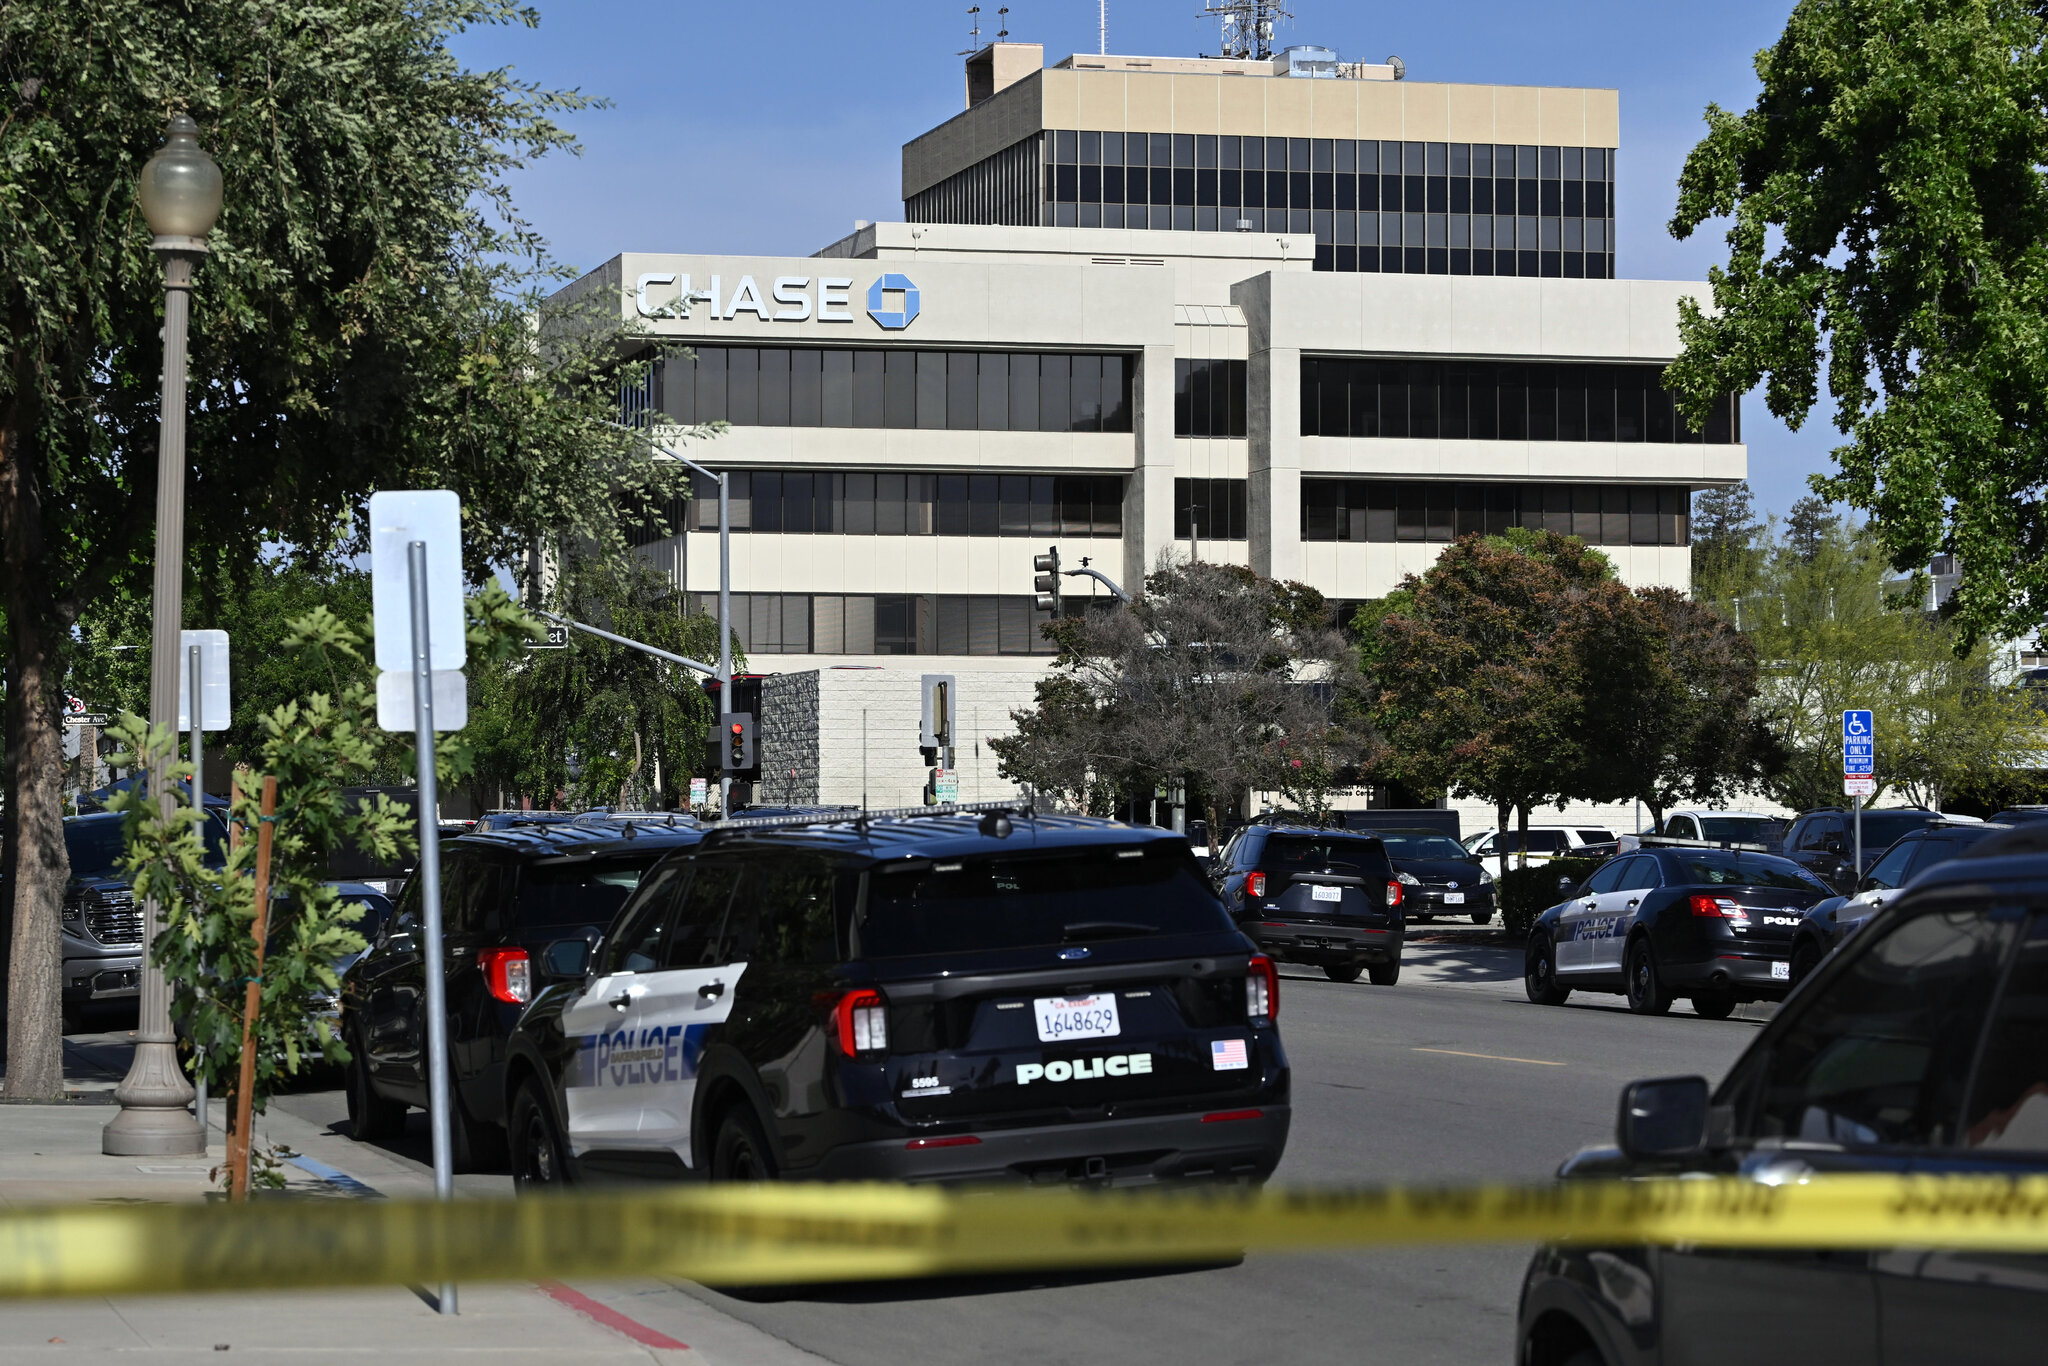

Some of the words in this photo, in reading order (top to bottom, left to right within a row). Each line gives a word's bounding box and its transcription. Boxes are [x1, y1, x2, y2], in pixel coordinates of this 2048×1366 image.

[636, 272, 854, 322] CHASE
[1845, 735, 1872, 745] PARKING
[1849, 745, 1867, 755] ONLY
[1848, 757, 1869, 765] MINIMUM
[1575, 917, 1616, 941] POLICE
[1763, 916, 1802, 926] POLI
[1044, 1009, 1113, 1034] 1648629
[597, 1025, 682, 1088] POLICE
[1016, 1053, 1153, 1085] POLICE
